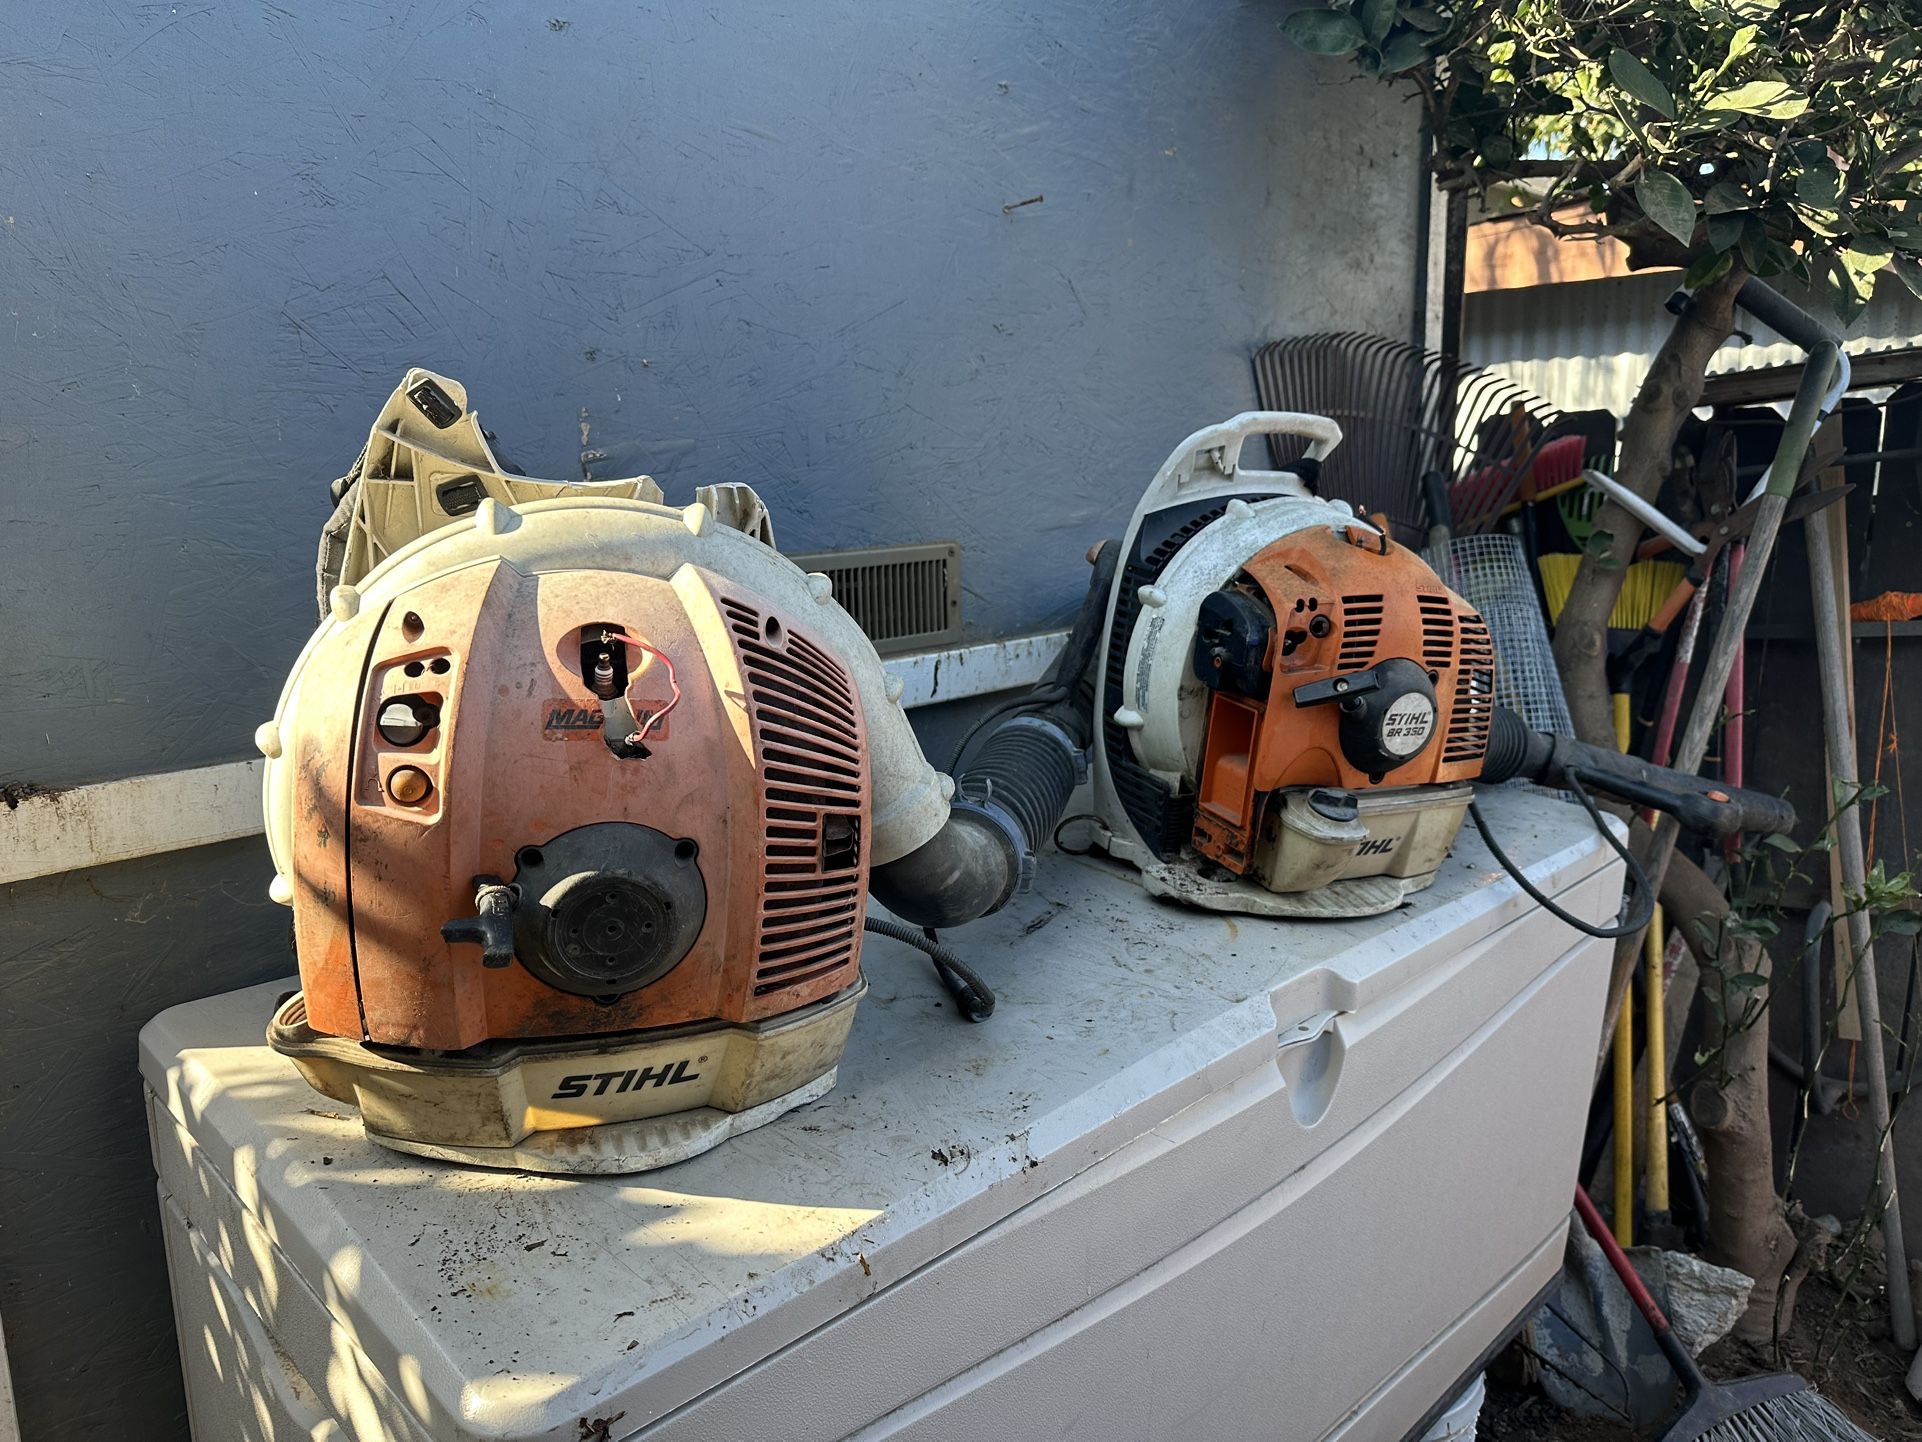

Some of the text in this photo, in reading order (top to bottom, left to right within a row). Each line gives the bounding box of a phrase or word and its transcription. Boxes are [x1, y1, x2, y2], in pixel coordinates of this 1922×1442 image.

[1386, 712, 1428, 726] STIHL
[1387, 727, 1425, 737] BR 350
[551, 1060, 700, 1099] STIHL
